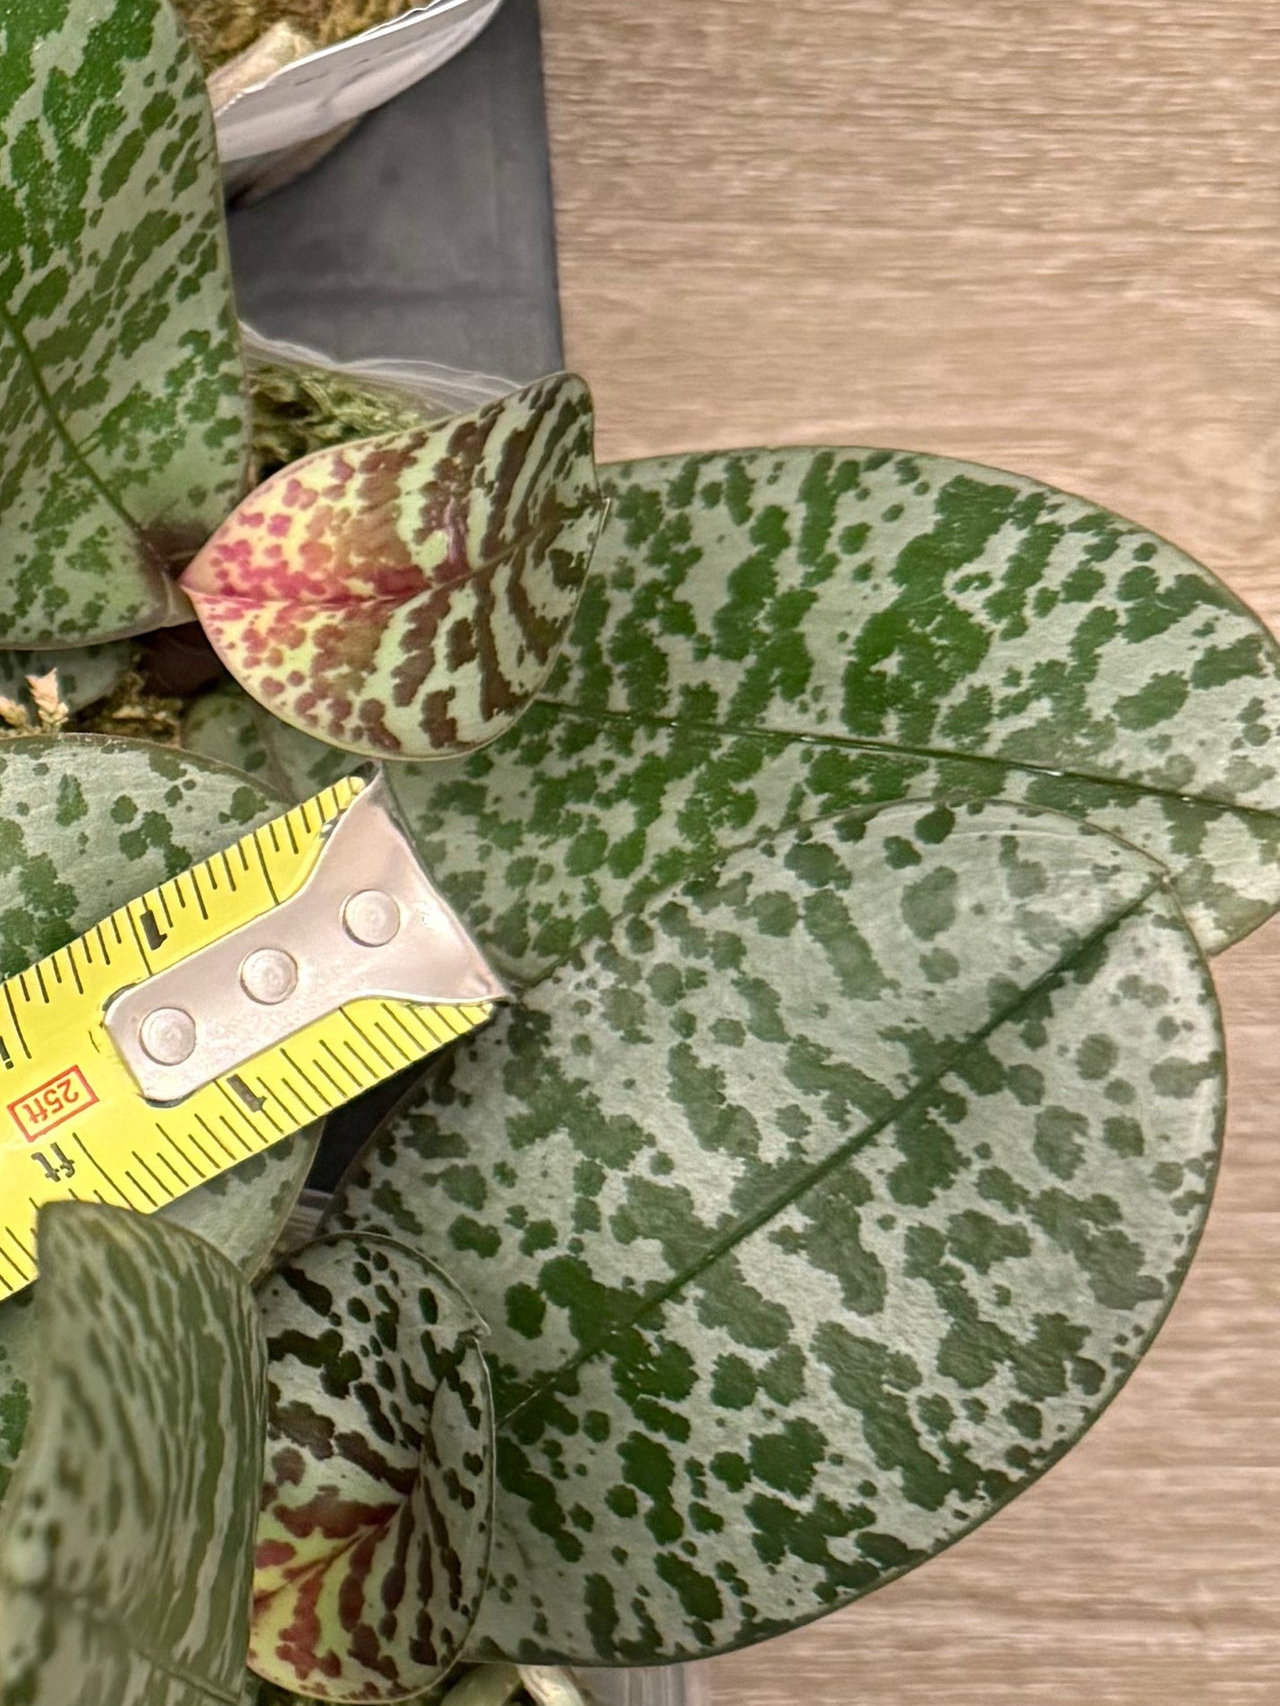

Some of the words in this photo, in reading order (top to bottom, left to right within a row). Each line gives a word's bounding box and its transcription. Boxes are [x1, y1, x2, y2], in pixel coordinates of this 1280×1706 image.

[140, 908, 168, 951] 1
[21, 1075, 80, 1125] 25ft
[226, 1074, 267, 1113] 1
[31, 1142, 76, 1183] ft
